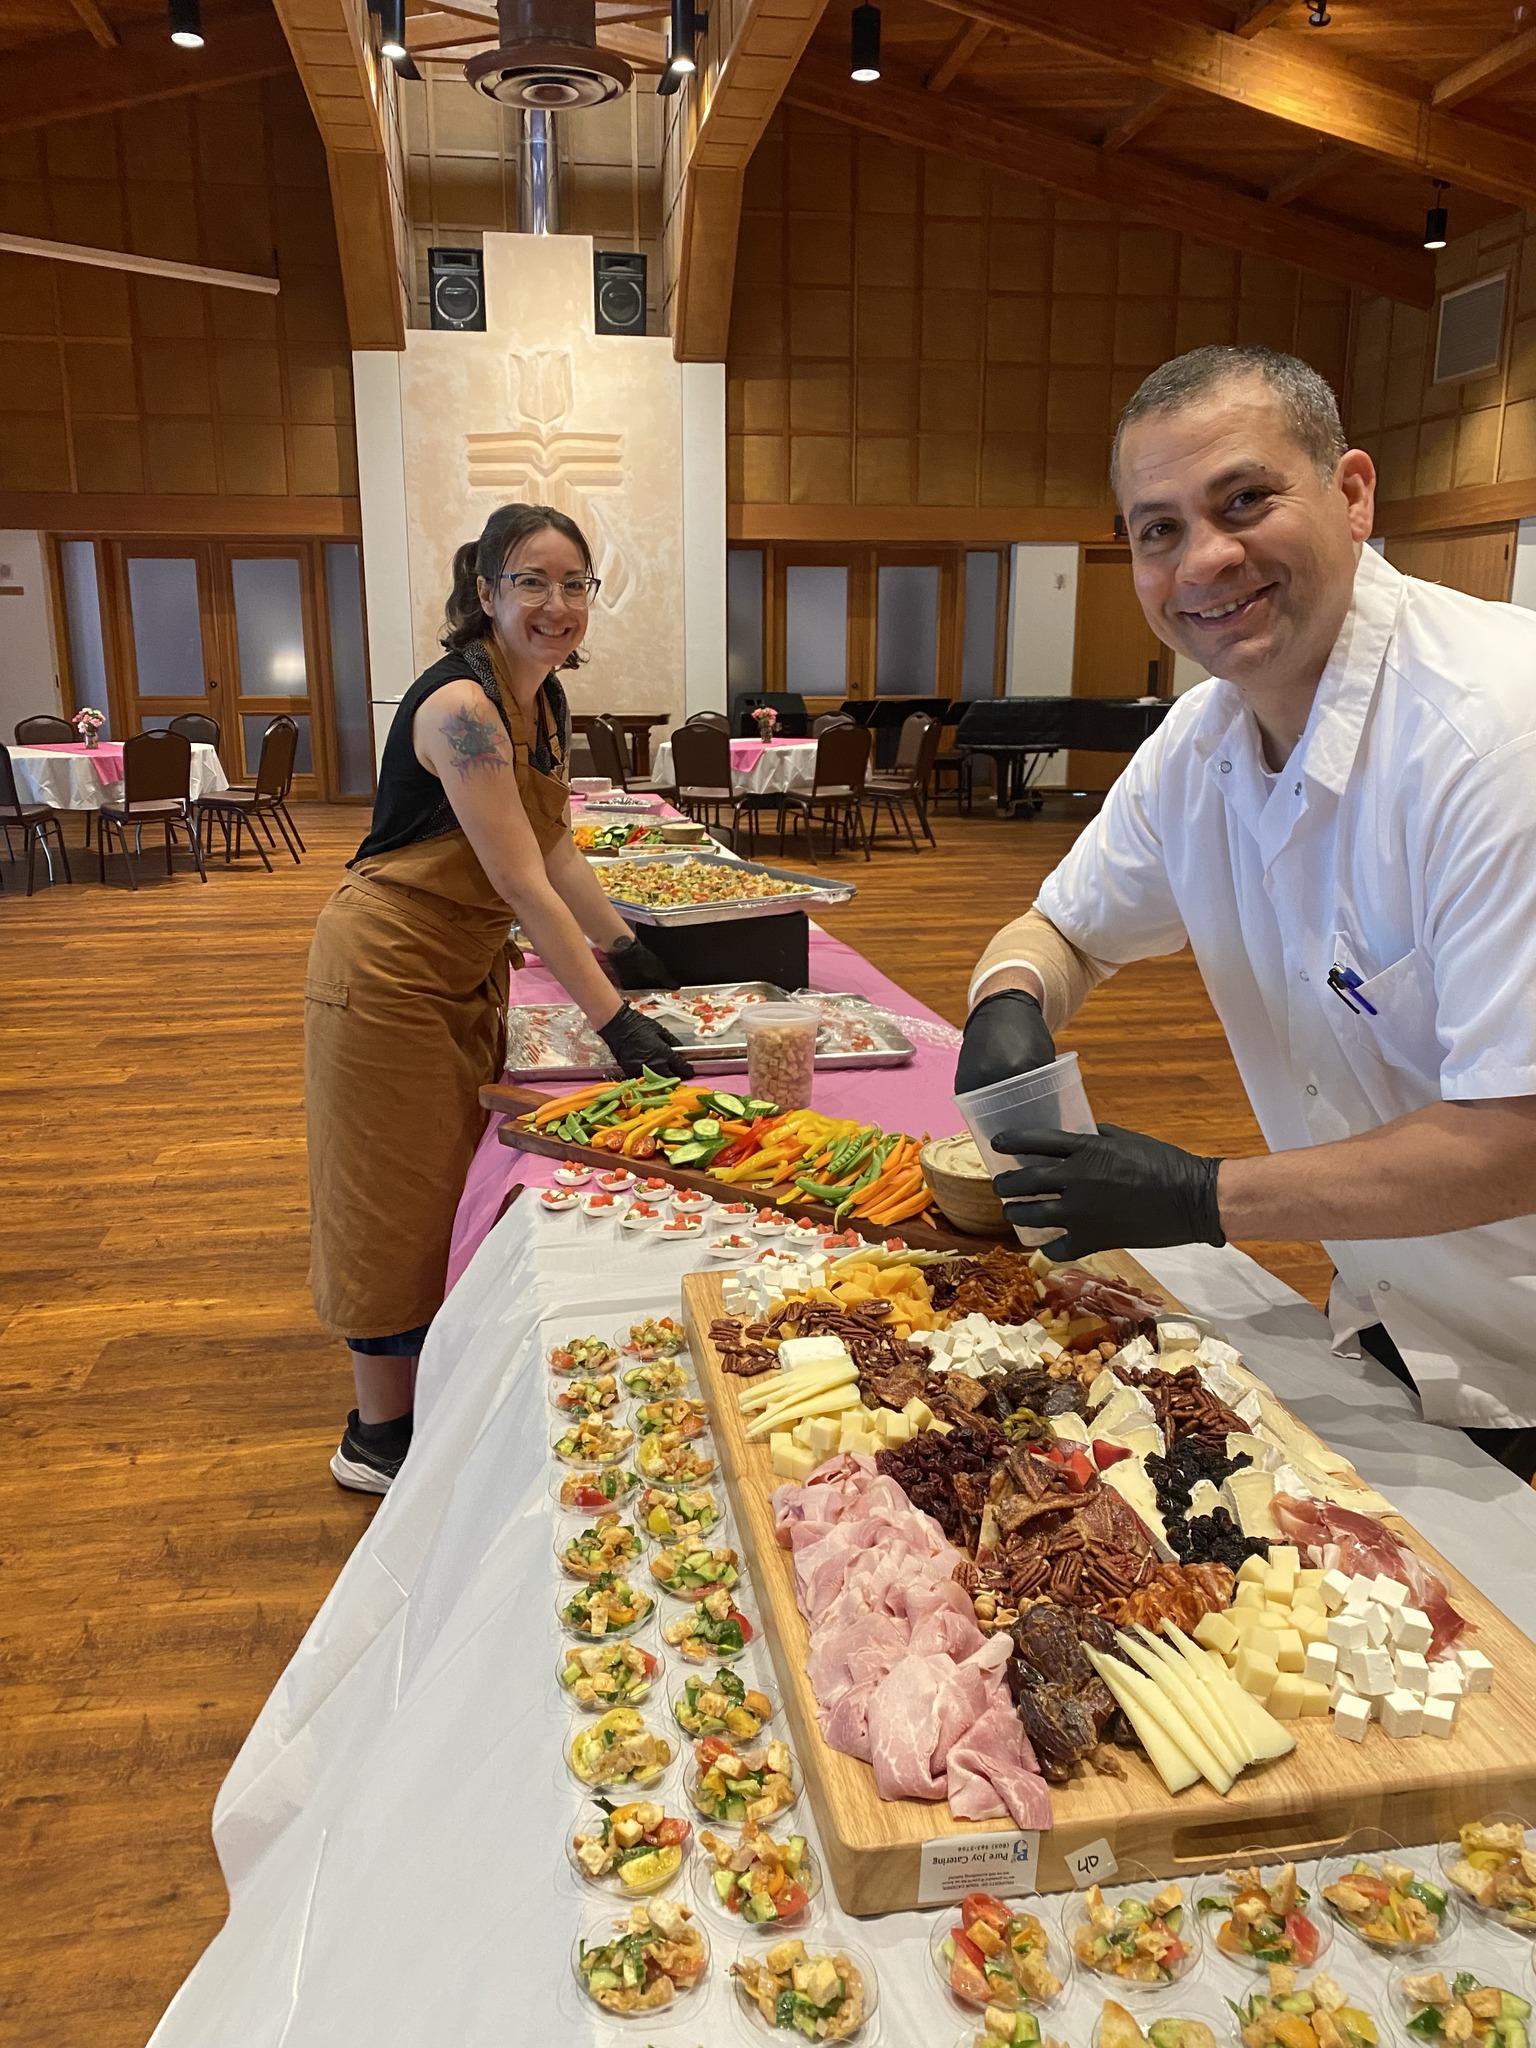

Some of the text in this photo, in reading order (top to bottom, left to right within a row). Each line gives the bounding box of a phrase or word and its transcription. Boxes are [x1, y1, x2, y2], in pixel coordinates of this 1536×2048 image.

[933, 1852, 1008, 1865] Pure Joy Catering
